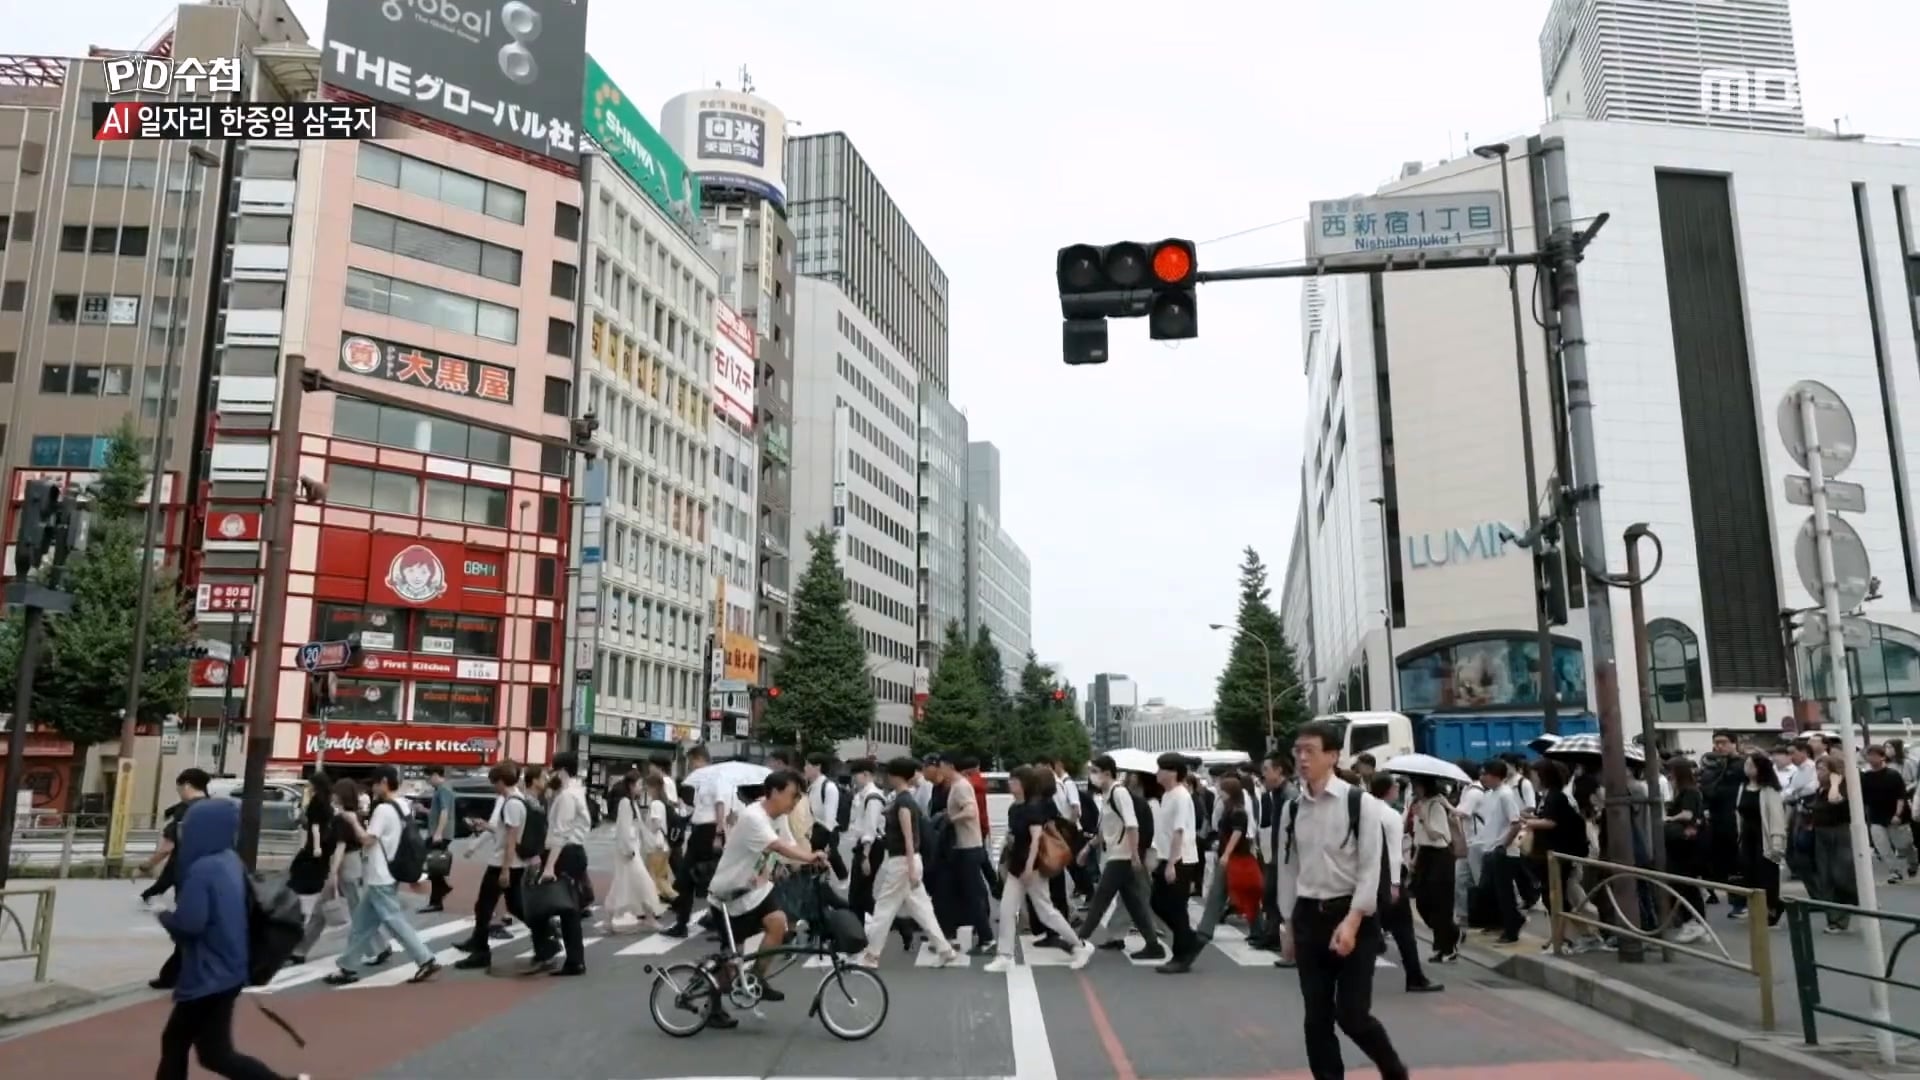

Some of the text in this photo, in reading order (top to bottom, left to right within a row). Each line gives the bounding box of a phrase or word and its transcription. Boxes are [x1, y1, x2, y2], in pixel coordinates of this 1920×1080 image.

[329, 40, 575, 151] THEグローバル社
[1321, 206, 1491, 237] 西新宿1丁目
[1355, 232, 1462, 251] Nishishinjuku 1
[396, 350, 509, 401] 大黒屋
[383, 659, 451, 672] First Kitchen
[306, 730, 365, 755] Wndy's
[394, 738, 433, 751] First
